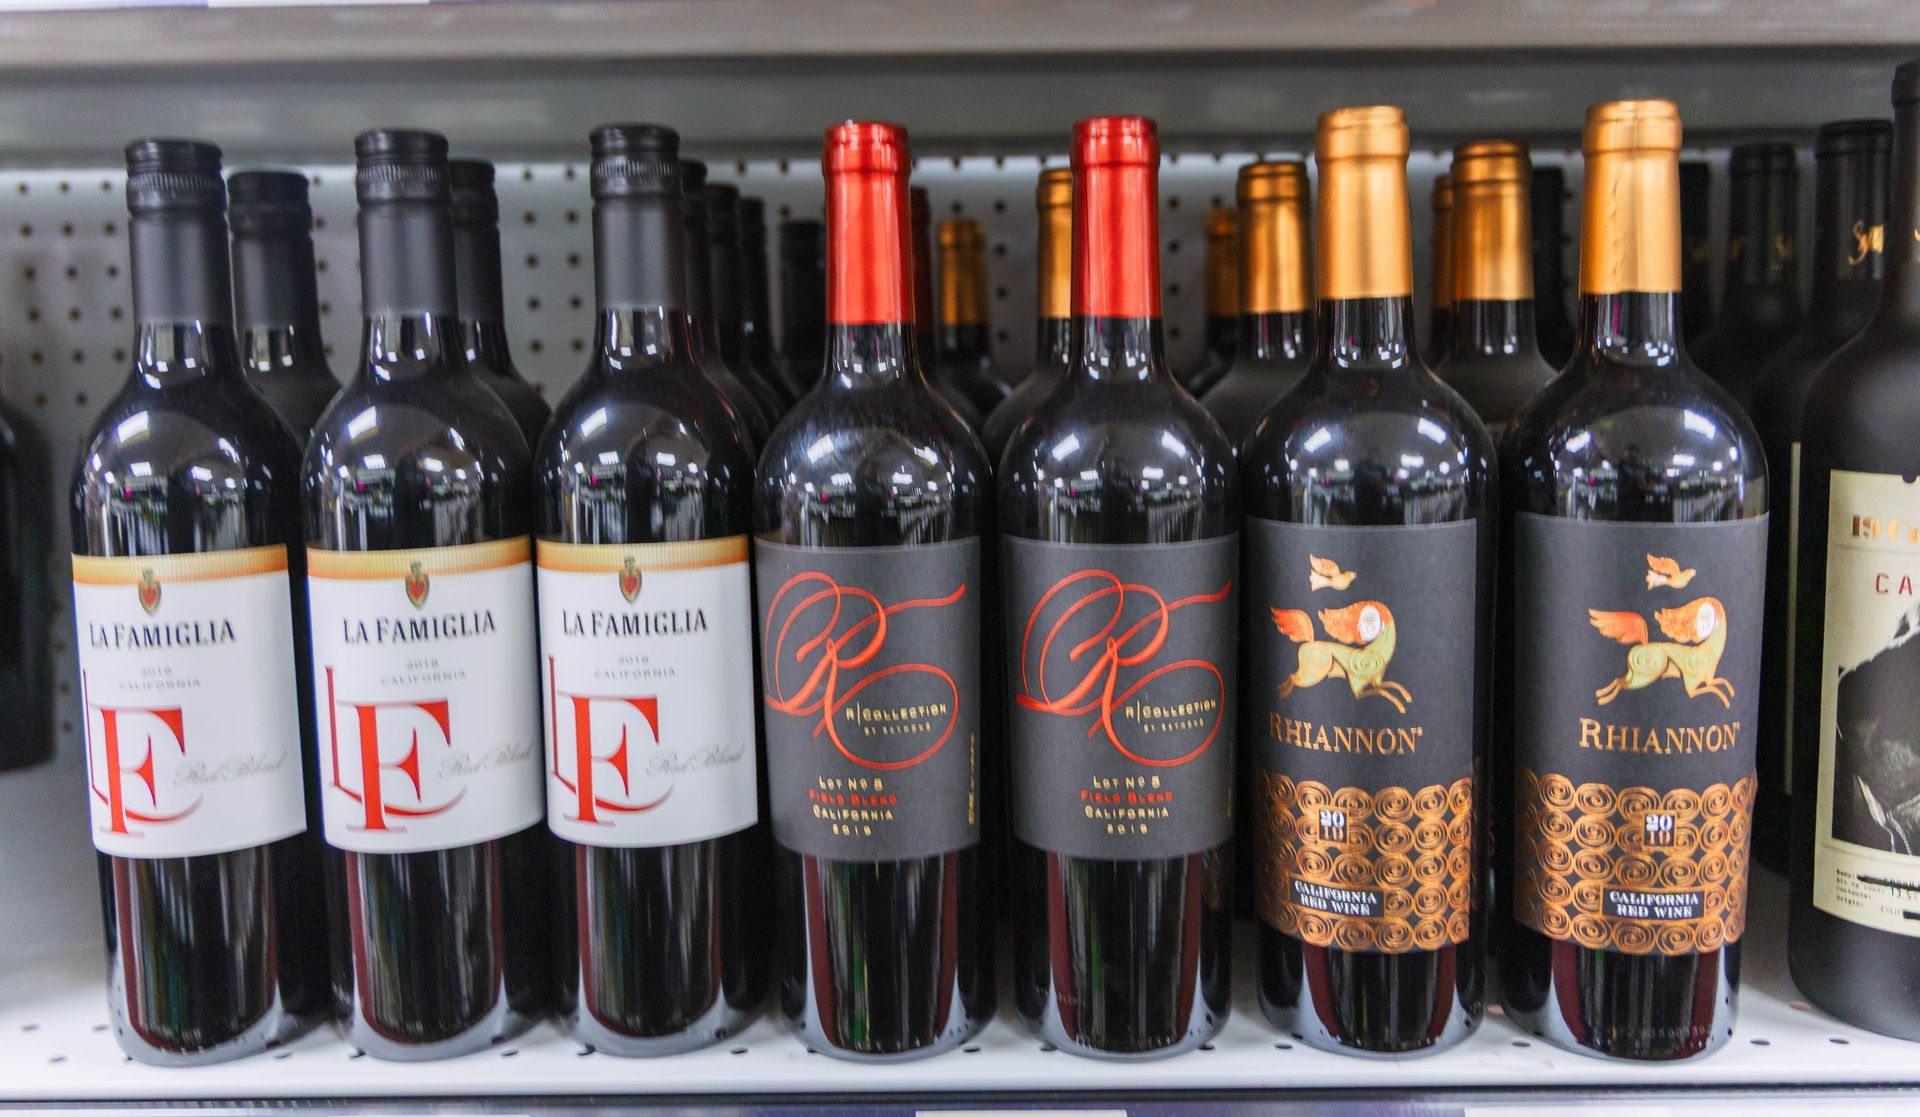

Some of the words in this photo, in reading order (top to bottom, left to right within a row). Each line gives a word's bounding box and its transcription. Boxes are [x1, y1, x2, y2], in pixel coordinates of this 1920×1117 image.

[89, 621, 109, 649] LA
[114, 617, 236, 649] FAMIGLIA
[342, 617, 369, 644] LA
[376, 608, 497, 644] FAMIGLIA
[562, 608, 585, 636] LA
[591, 606, 708, 637] FAMIGLIA
[1320, 809, 1345, 828] 20
[1646, 814, 1672, 832] 20
[1294, 879, 1378, 905] CALIFORNIA
[1609, 890, 1698, 906] CALIFORNIA
[1300, 893, 1328, 910] RED
[1331, 900, 1370, 916] WINE
[1617, 903, 1649, 918] RED
[1654, 905, 1692, 919] WINE
